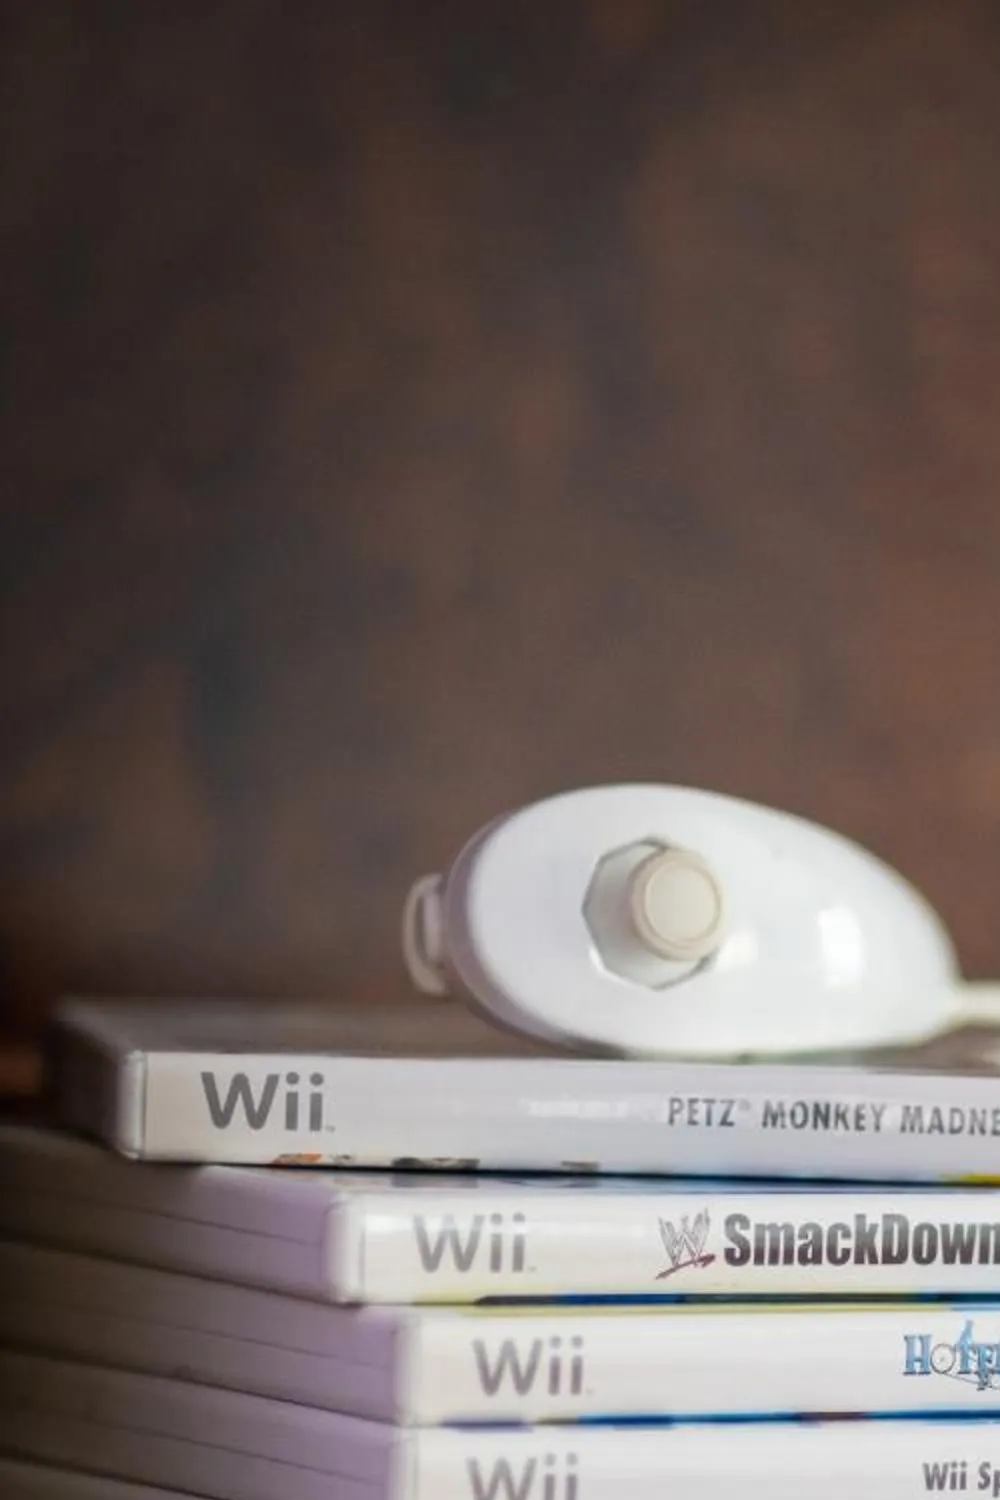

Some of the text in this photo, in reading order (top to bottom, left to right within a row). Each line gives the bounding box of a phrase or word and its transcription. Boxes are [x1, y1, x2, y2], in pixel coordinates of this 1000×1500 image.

[201, 1071, 326, 1132] Wii
[761, 1100, 886, 1133] MONKEY
[411, 1213, 528, 1273] Wii
[472, 1335, 585, 1397] Wii
[922, 1460, 968, 1491] Wii
